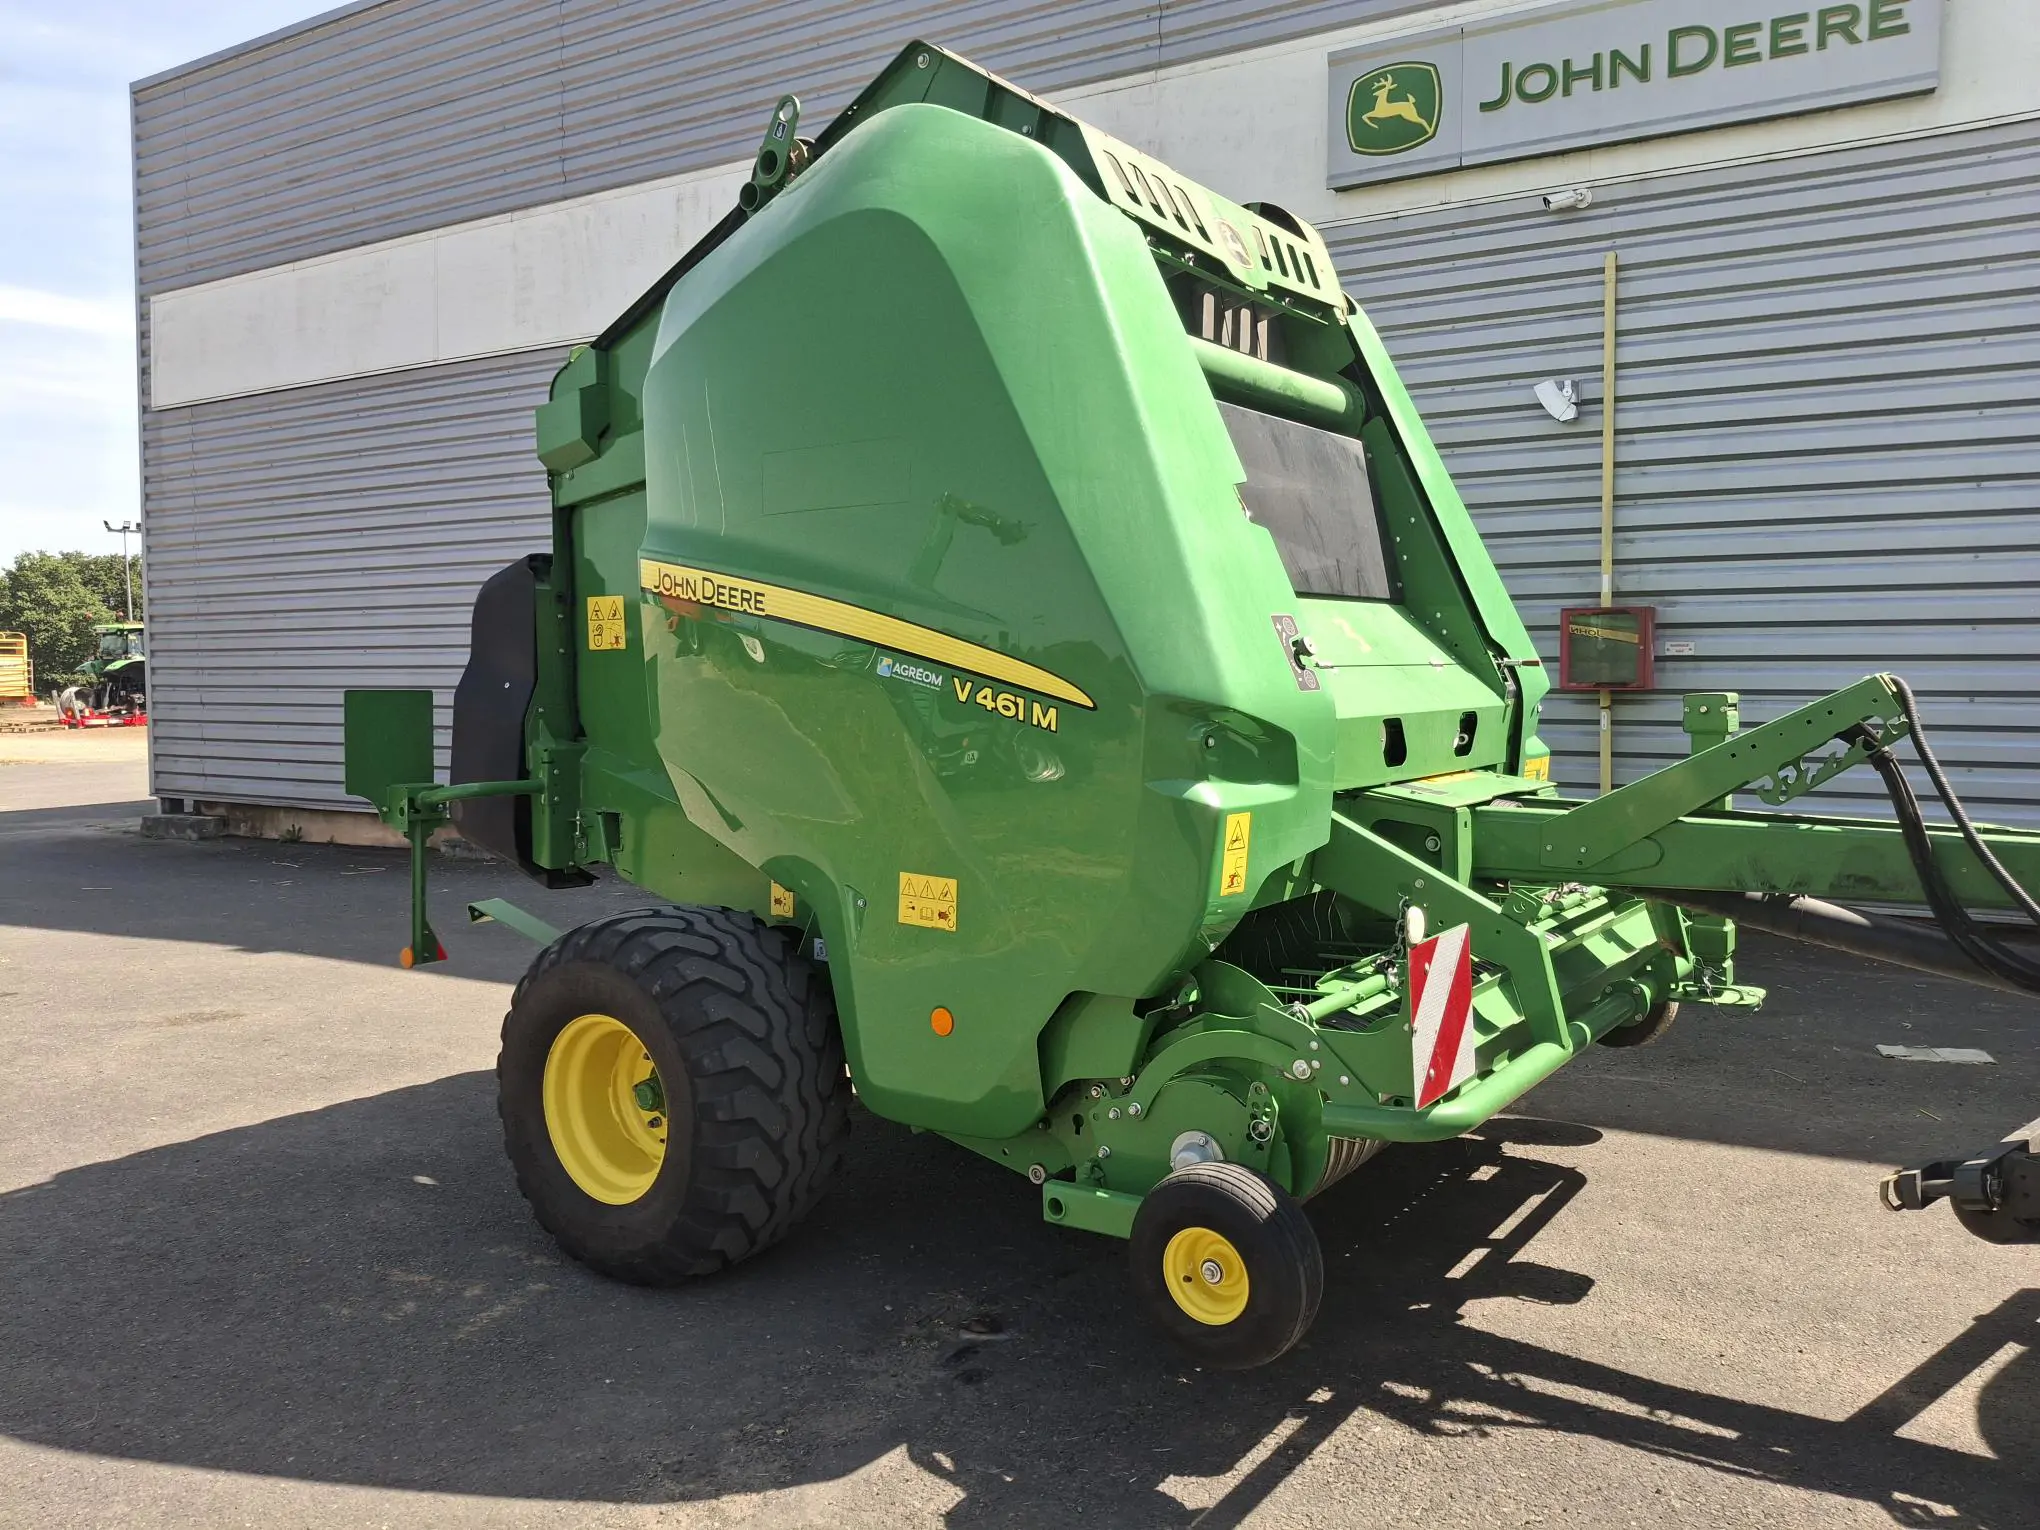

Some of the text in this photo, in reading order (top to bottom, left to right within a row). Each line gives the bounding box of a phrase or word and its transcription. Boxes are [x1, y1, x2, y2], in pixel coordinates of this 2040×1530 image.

[1479, 0, 1911, 112] JOHN DEERE
[653, 567, 766, 613] JOHN DEERE
